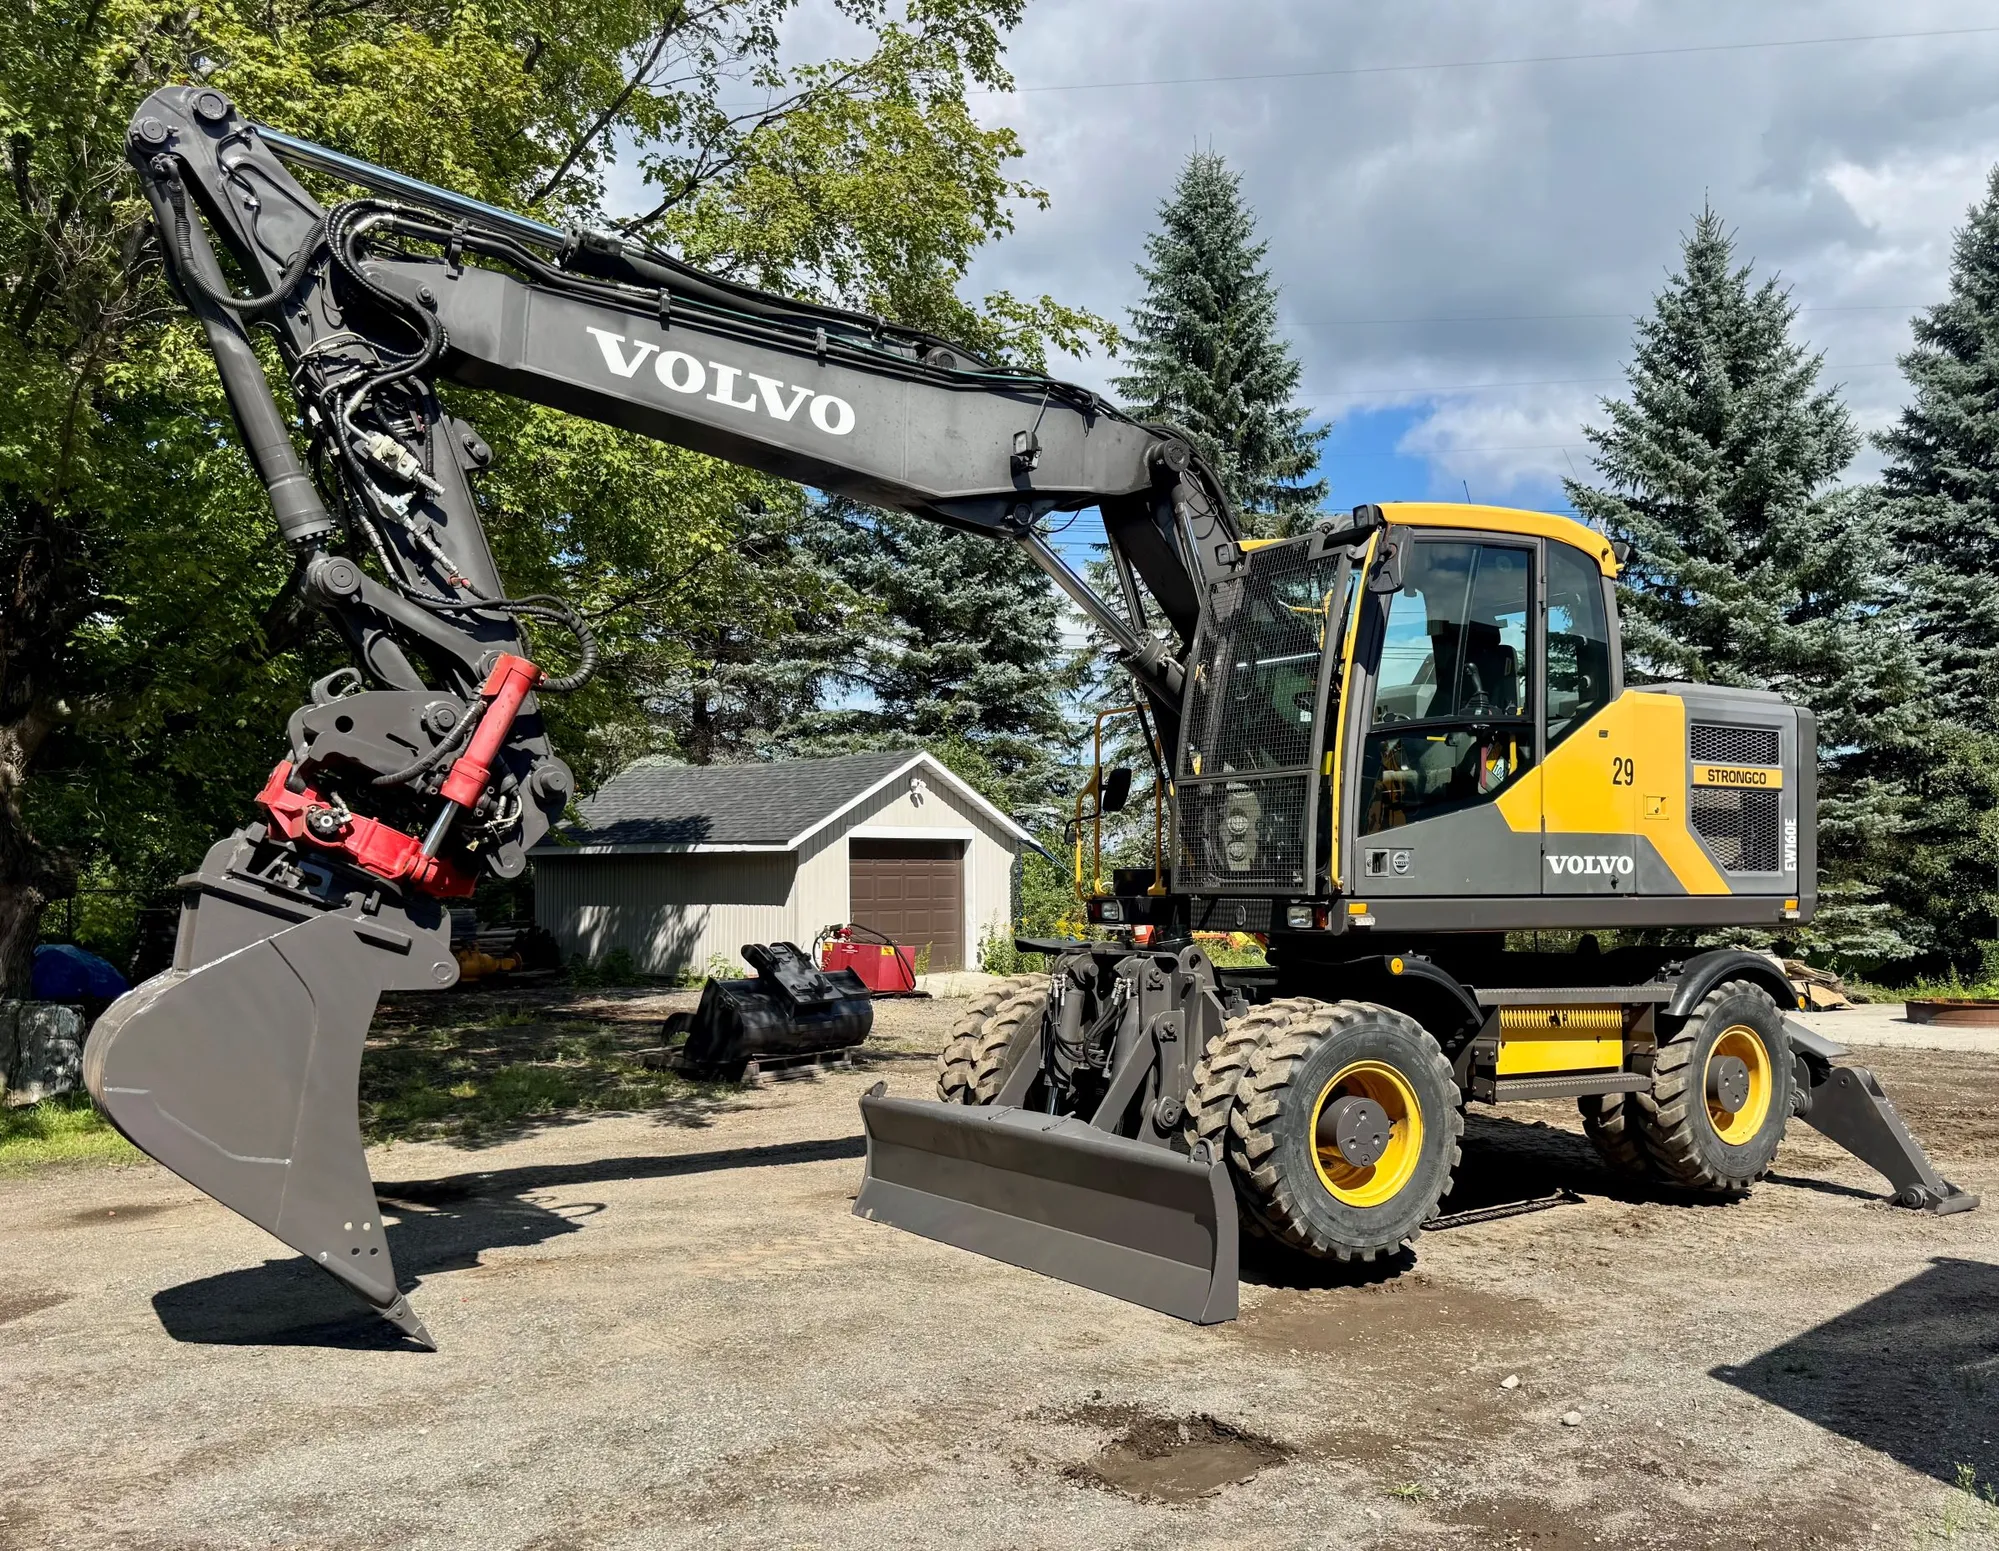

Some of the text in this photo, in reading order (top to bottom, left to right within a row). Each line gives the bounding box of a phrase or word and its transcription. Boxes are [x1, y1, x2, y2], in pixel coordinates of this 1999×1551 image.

[586, 326, 856, 435] VOLVO
[1612, 757, 1634, 786] 29
[1707, 769, 1767, 785] STRONGCO
[1784, 818, 1797, 871] EW160E
[1545, 855, 1634, 874] VOLVO
